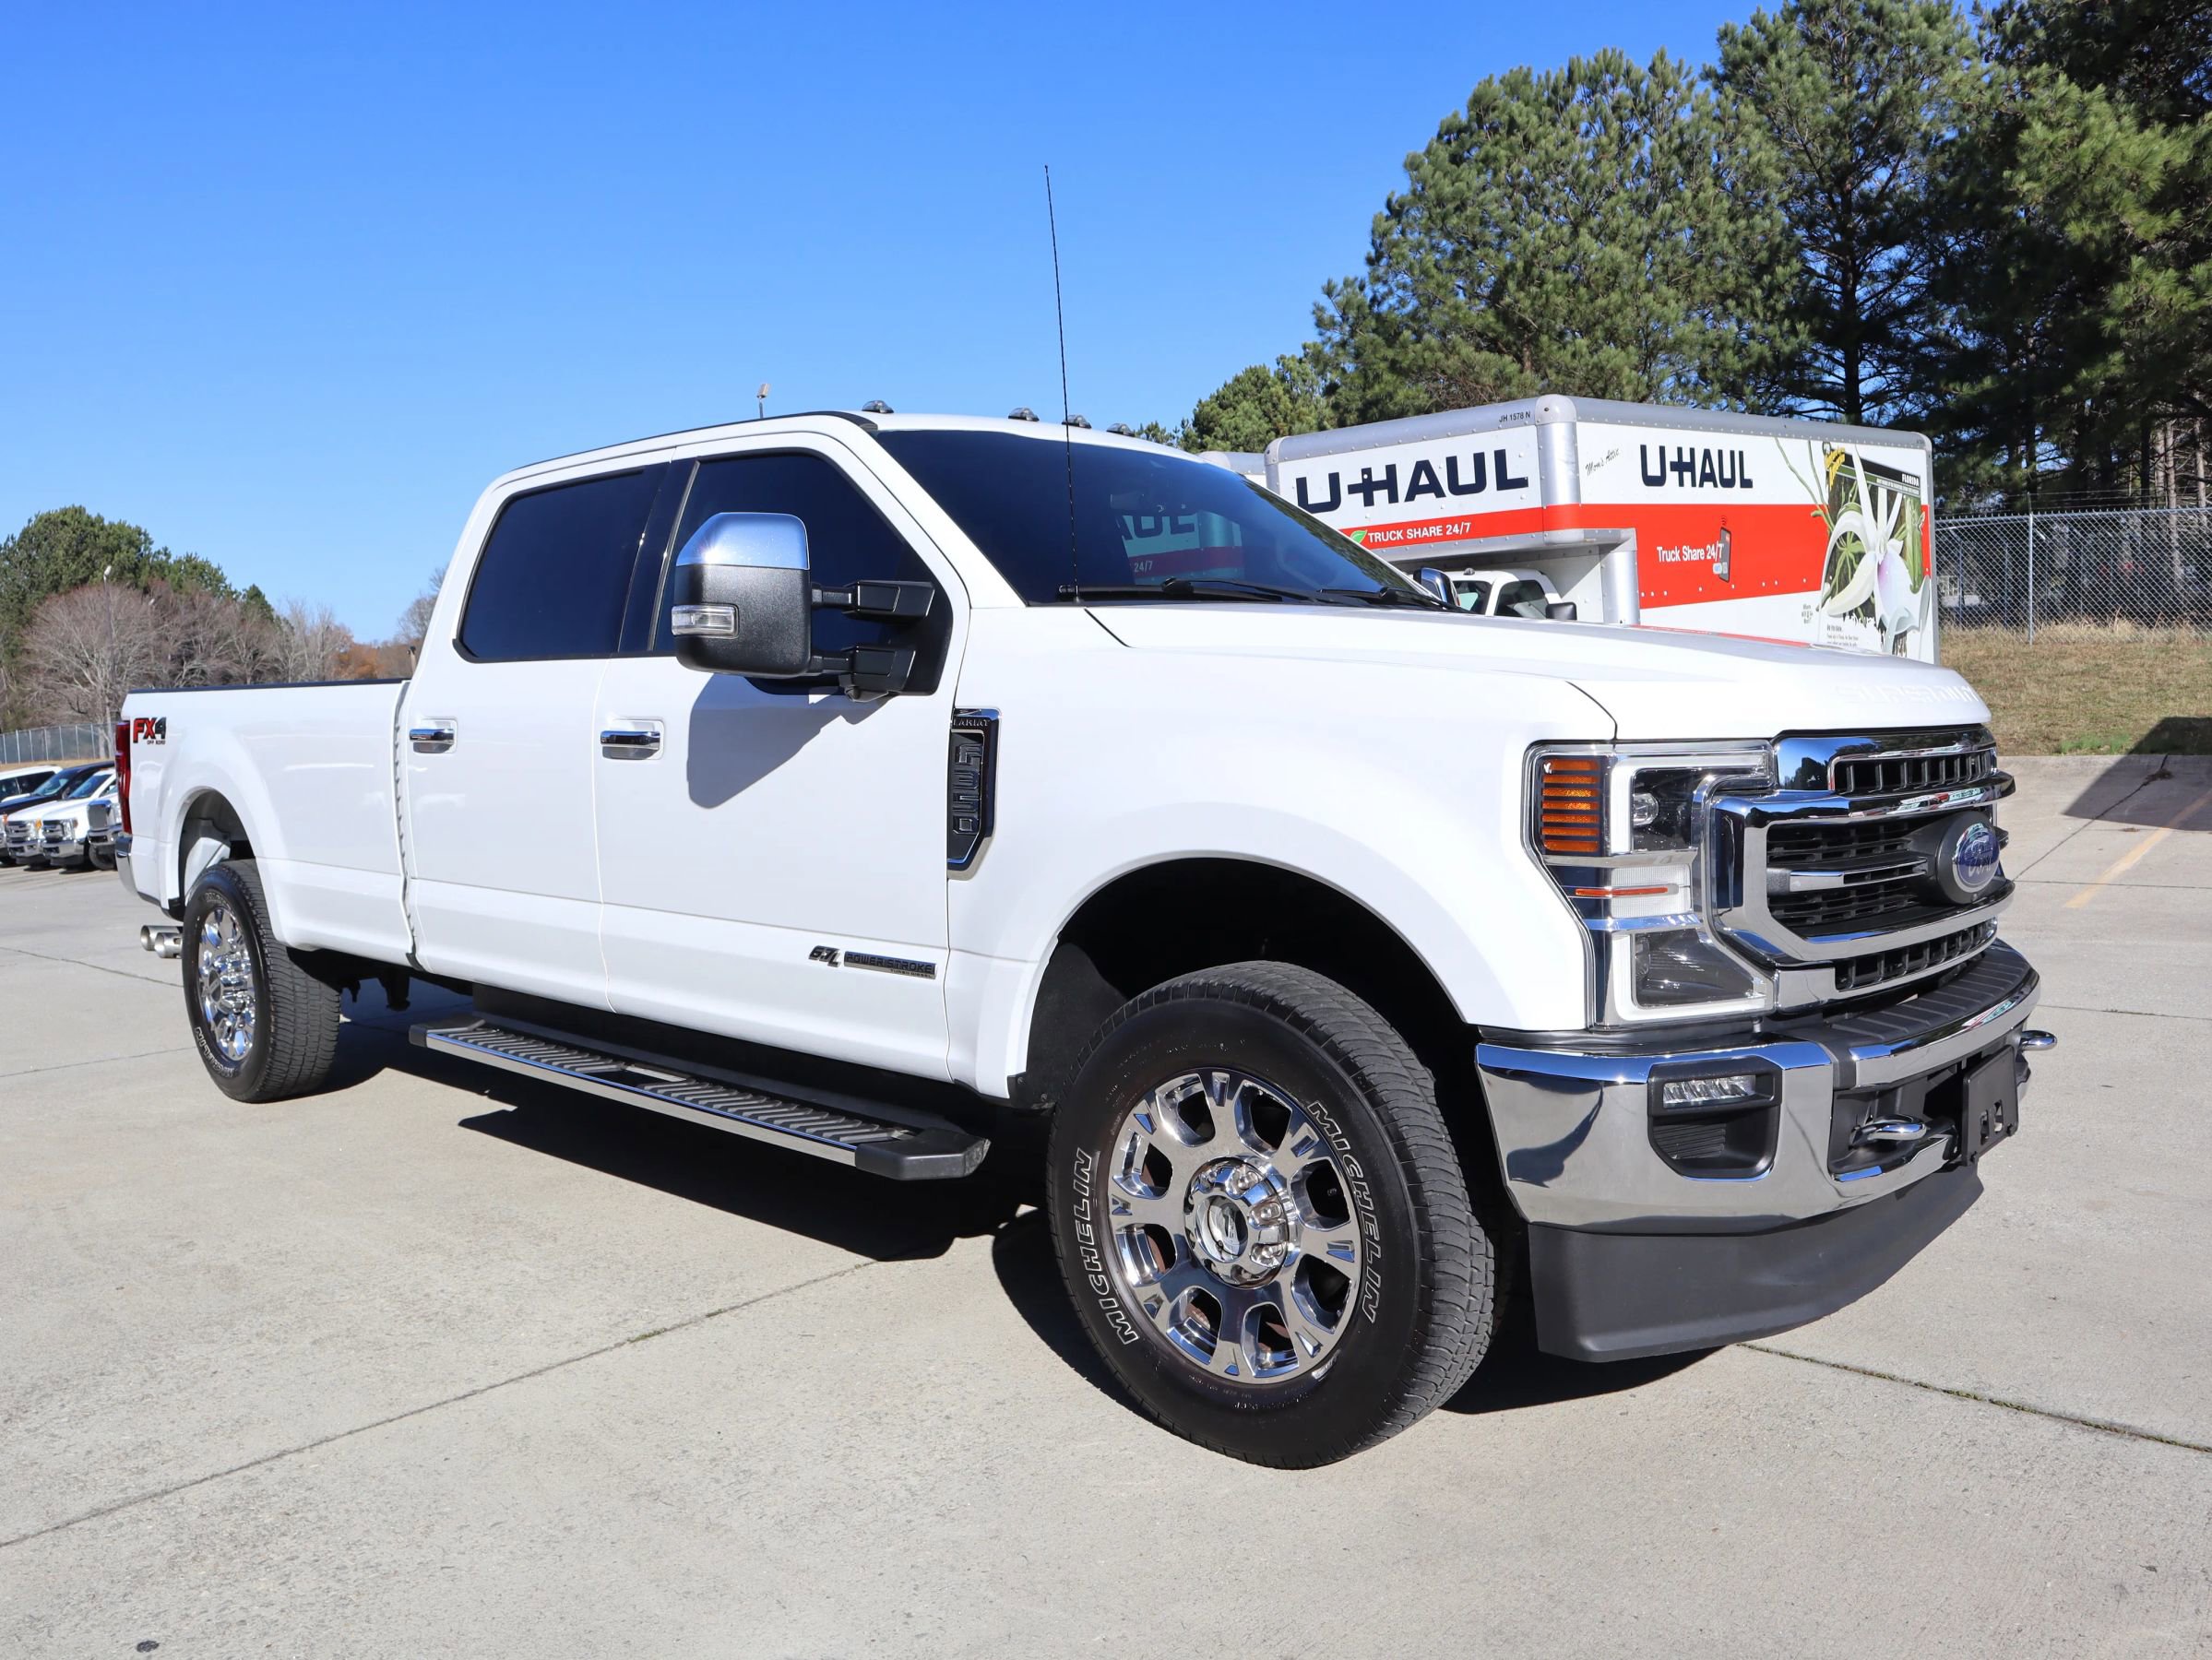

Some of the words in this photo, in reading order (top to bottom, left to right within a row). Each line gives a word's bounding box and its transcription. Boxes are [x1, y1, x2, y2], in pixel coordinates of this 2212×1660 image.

[1499, 414, 1508, 422] JH
[1509, 412, 1524, 421] 1578
[1525, 410, 1531, 419] N
[1639, 444, 1754, 489] U-HAUL
[1295, 449, 1528, 514] U-HAUL
[1901, 473, 1920, 487] FLORIDA
[1368, 528, 1404, 543] TRUCK
[1406, 525, 1443, 540] SHARE
[1445, 522, 1471, 536] 24/7
[1656, 546, 1681, 562] Truck
[1682, 545, 1705, 561] Share
[1706, 540, 1724, 562] 24/7
[1134, 560, 1153, 574] 24/7
[133, 717, 167, 743] FX4
[952, 718, 991, 727] LARIAT
[1307, 1099, 1382, 1324] MICHELIN
[1074, 1147, 1140, 1346] MICHELIN
